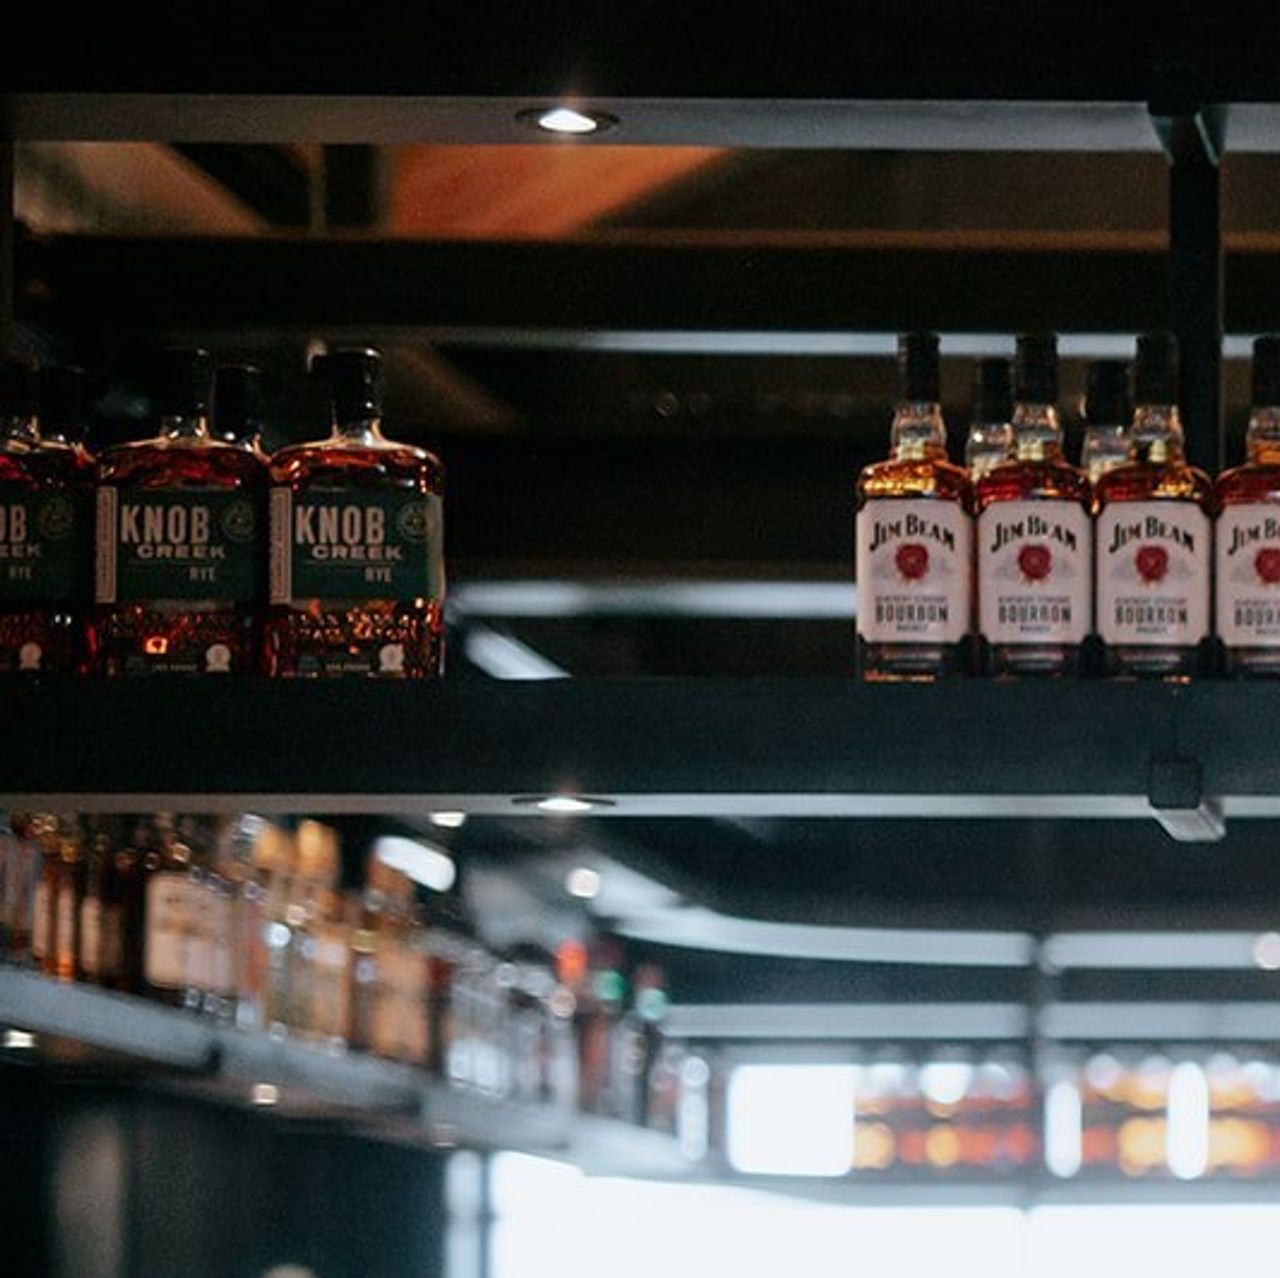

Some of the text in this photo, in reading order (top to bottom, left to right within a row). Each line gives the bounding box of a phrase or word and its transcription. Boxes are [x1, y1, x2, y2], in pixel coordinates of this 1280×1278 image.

[121, 505, 209, 543] KNOB
[296, 505, 384, 544] KNOB
[869, 514, 955, 551] JIM BEAM
[991, 516, 1076, 551] JIM BEAM
[1109, 517, 1195, 553] JIM BEAM
[1228, 525, 1260, 555] JIM
[0, 544, 41, 557] EEK
[137, 544, 225, 559] CREEK
[312, 544, 402, 559] CREEK
